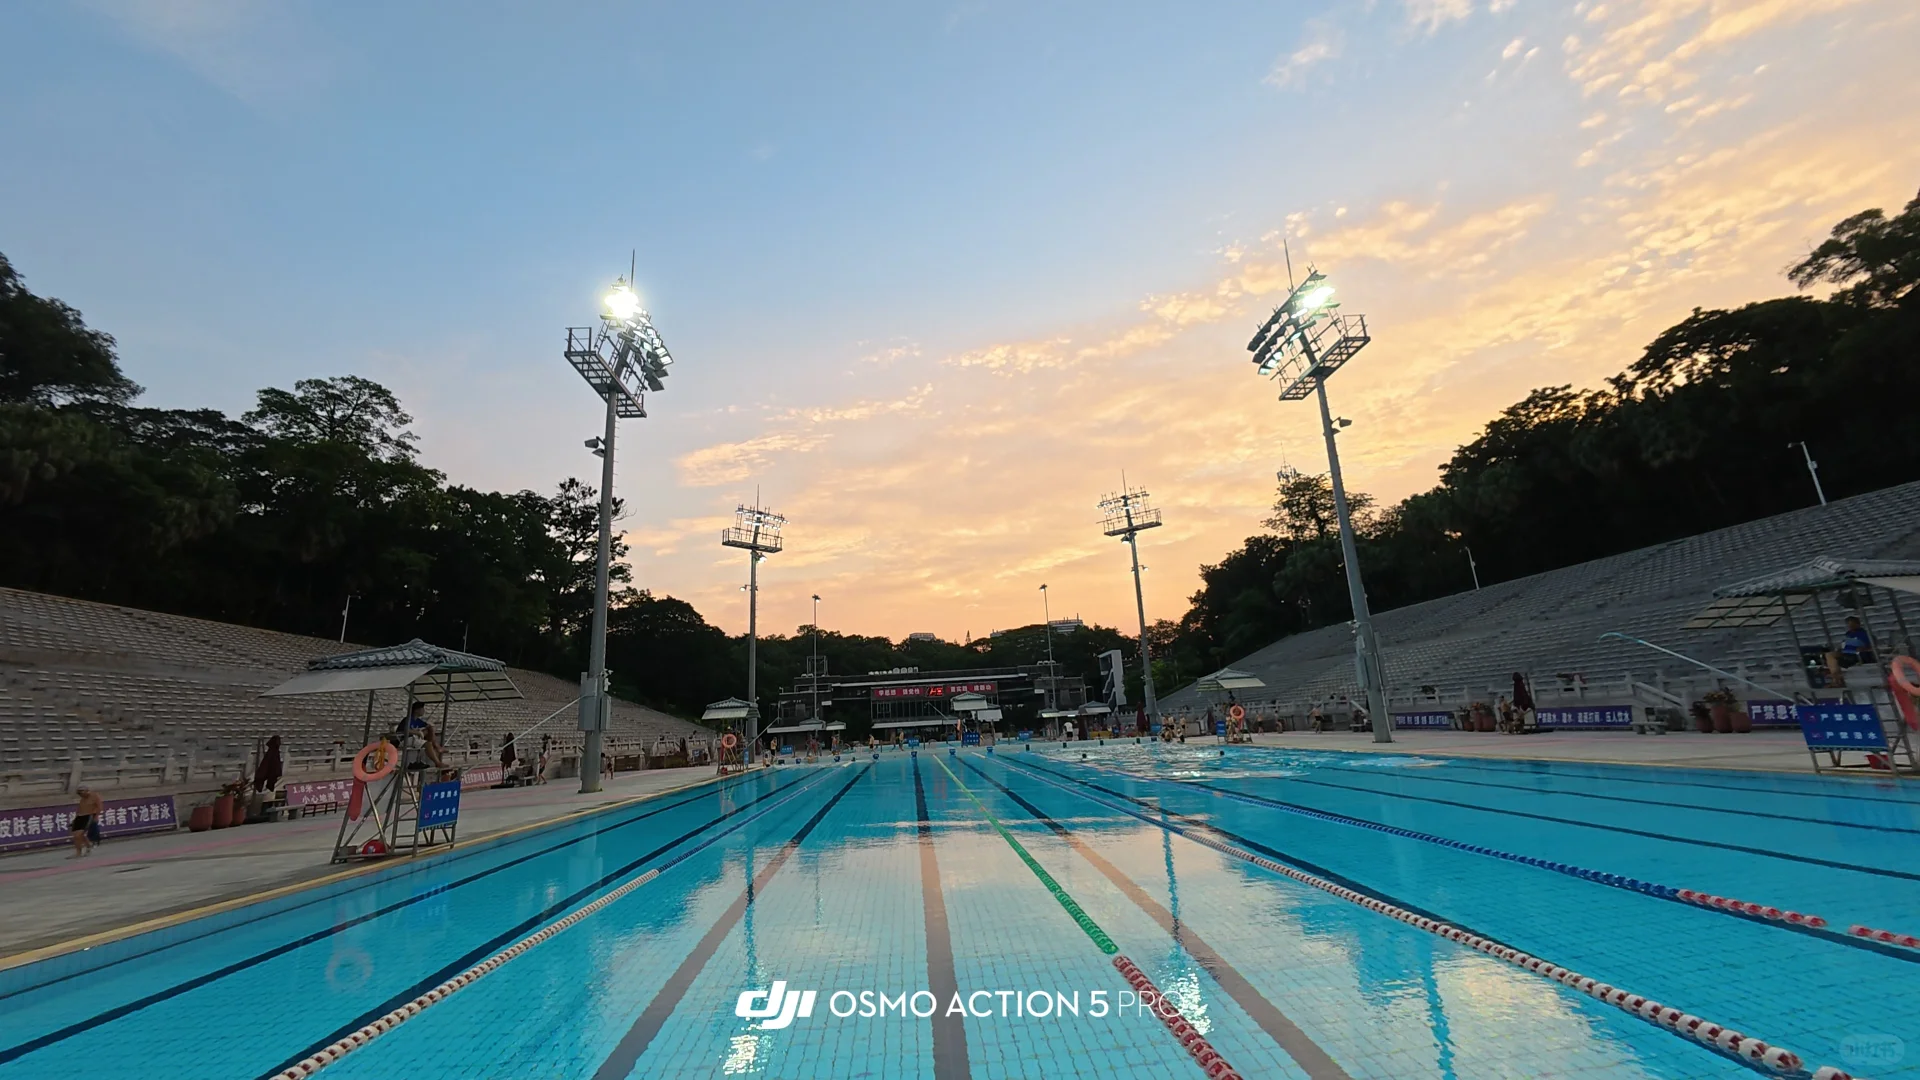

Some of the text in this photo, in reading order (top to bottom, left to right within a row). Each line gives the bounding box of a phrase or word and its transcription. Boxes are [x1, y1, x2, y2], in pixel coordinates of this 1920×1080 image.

[293, 784, 313, 794] 1.8米
[302, 792, 336, 804] 小心地滑
